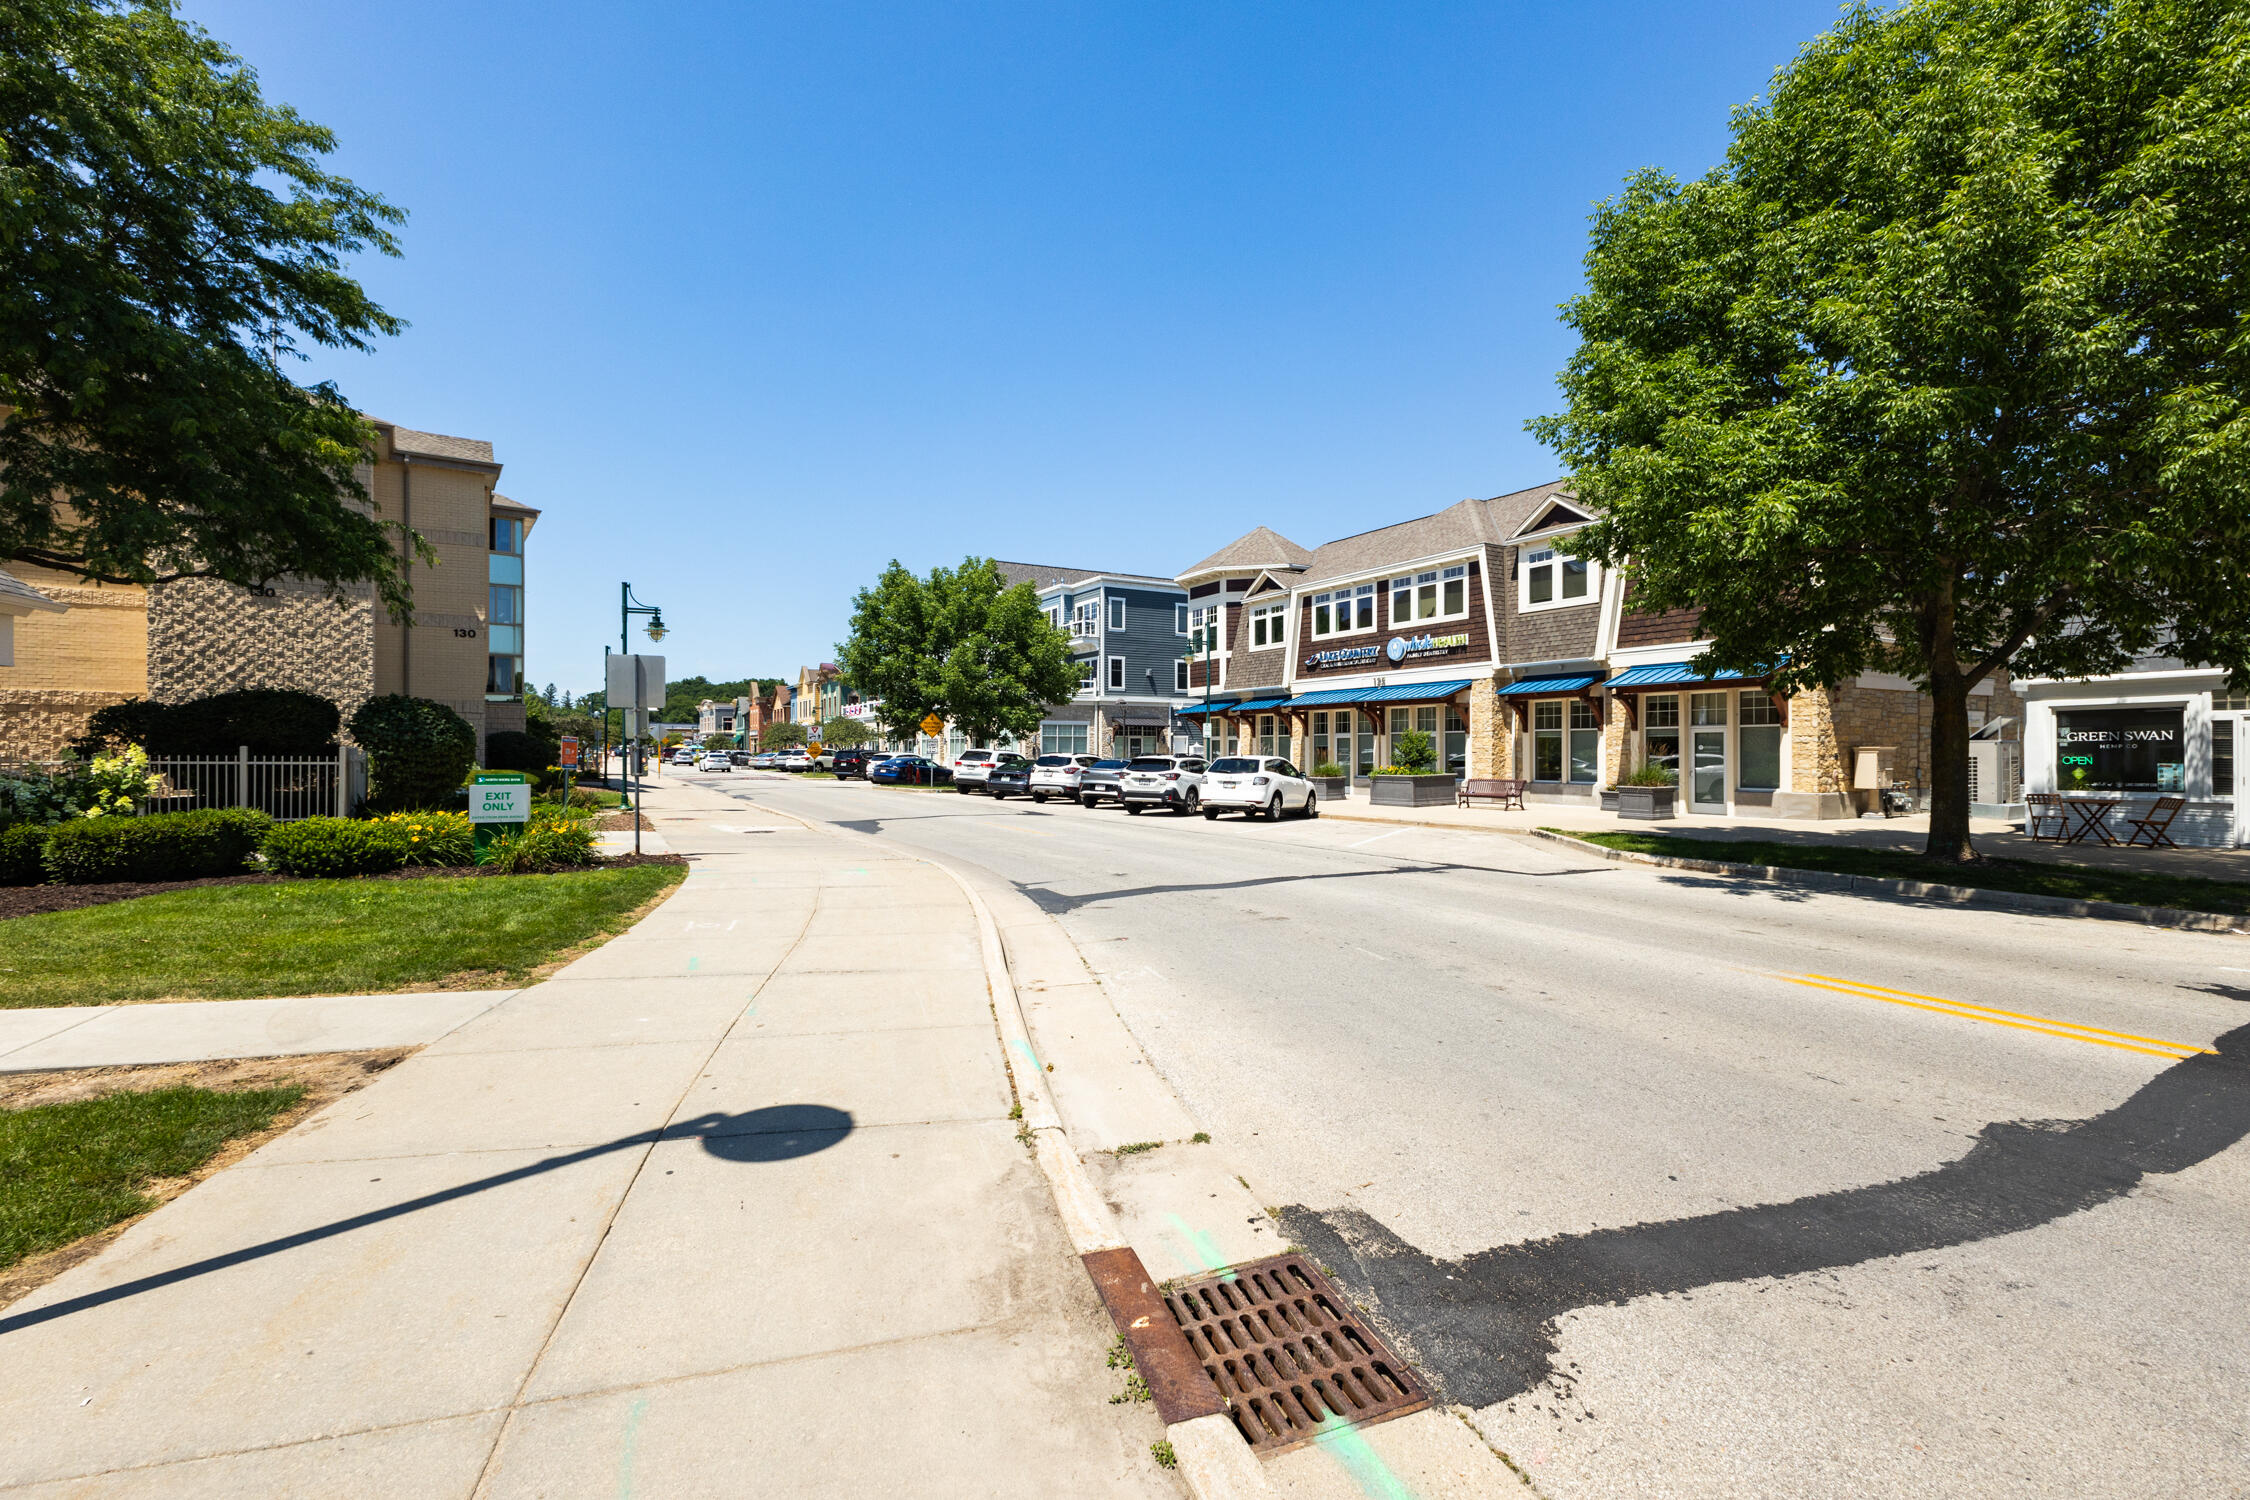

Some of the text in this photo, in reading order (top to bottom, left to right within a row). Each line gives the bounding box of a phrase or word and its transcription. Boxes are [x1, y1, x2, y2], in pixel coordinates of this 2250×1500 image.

[453, 629, 476, 638] 130
[2066, 730, 2174, 742] GREEN SWAN
[2062, 756, 2093, 765] OPEN
[485, 792, 511, 800] EXIT
[482, 802, 514, 811] ONLY
